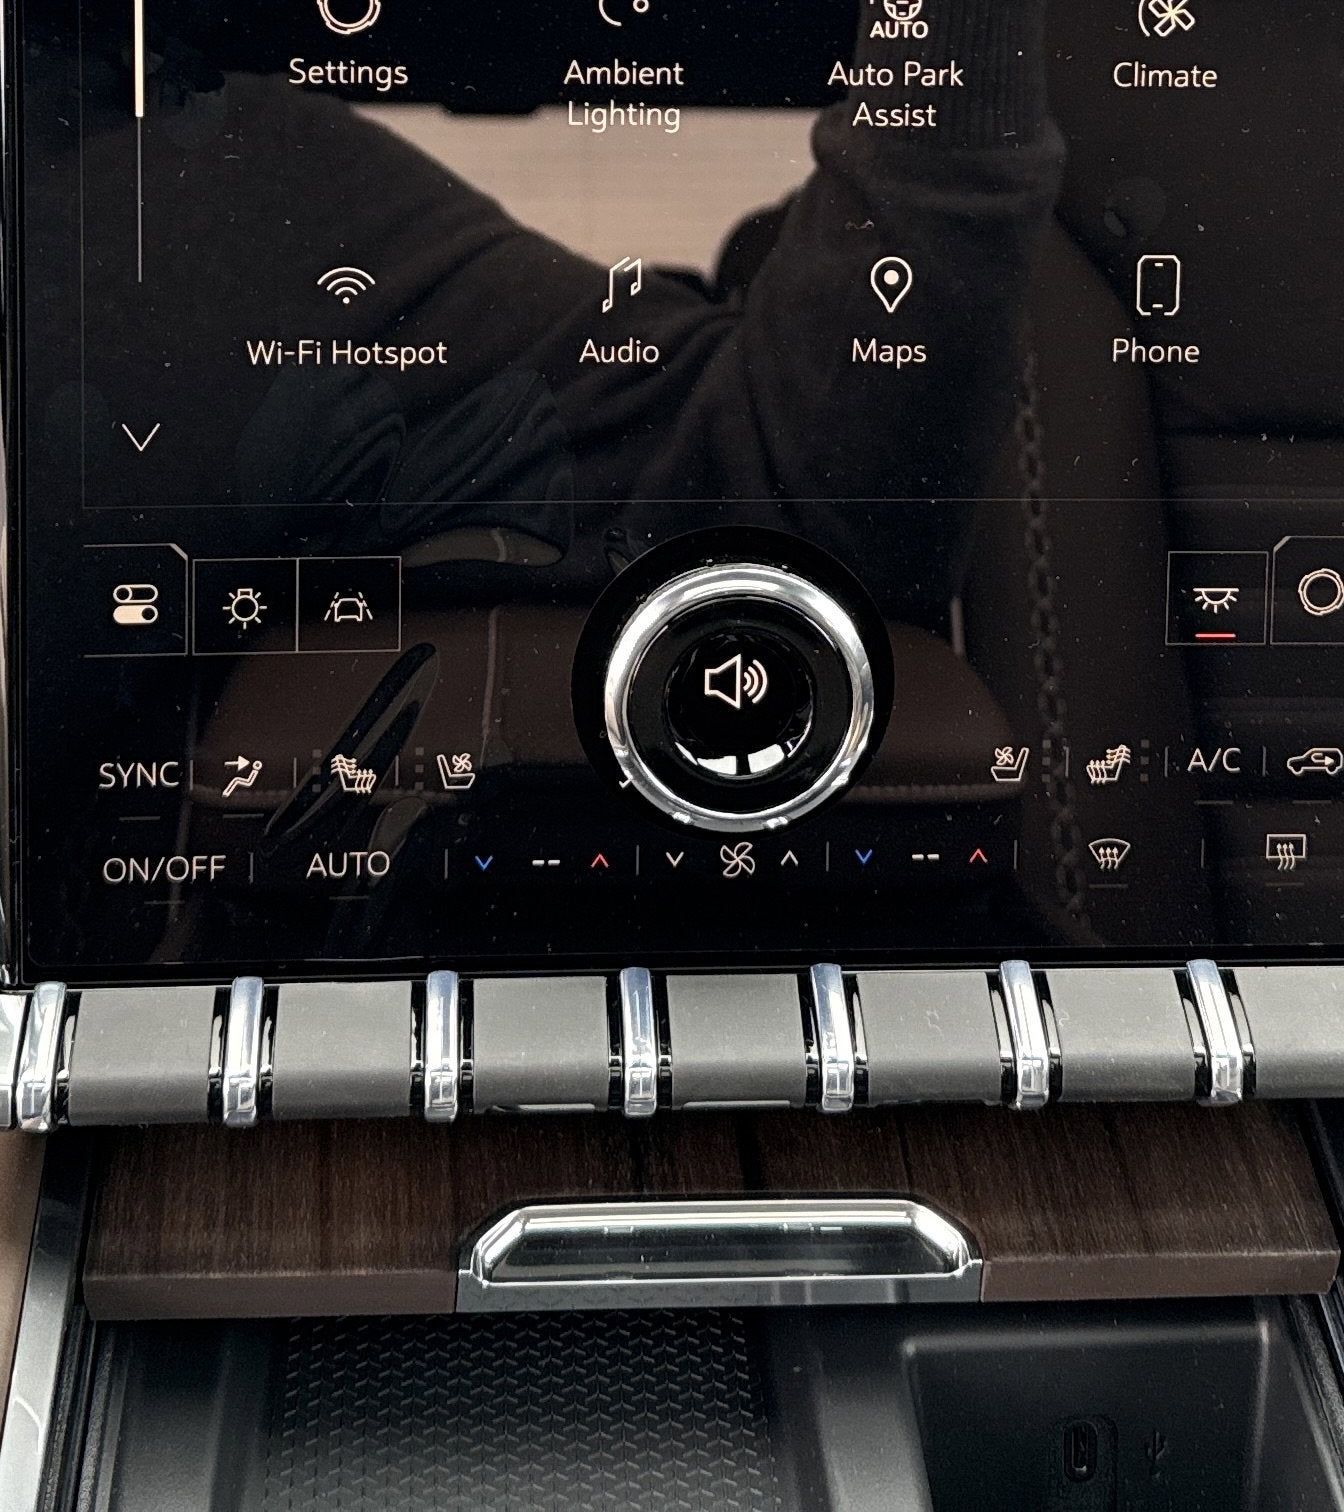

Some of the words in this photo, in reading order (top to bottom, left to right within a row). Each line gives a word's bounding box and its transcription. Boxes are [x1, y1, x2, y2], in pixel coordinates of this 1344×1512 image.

[869, 20, 929, 38] AUTO
[288, 59, 409, 91] Settings
[564, 60, 685, 86] Ambient
[827, 60, 894, 87] Auto
[904, 59, 964, 87] Park
[1113, 61, 1218, 90] Climate
[567, 101, 682, 134] Lighting
[852, 102, 937, 127] Assist
[246, 340, 322, 366] Wi-Fi
[331, 340, 448, 371] Hotspot
[579, 338, 660, 364] Audio
[851, 337, 927, 369] Maps
[1112, 338, 1201, 364] Phone
[1187, 747, 1241, 773] A/C
[99, 761, 180, 789] SYNC
[102, 854, 227, 884] ON/OFF
[306, 851, 391, 879] AUTO
